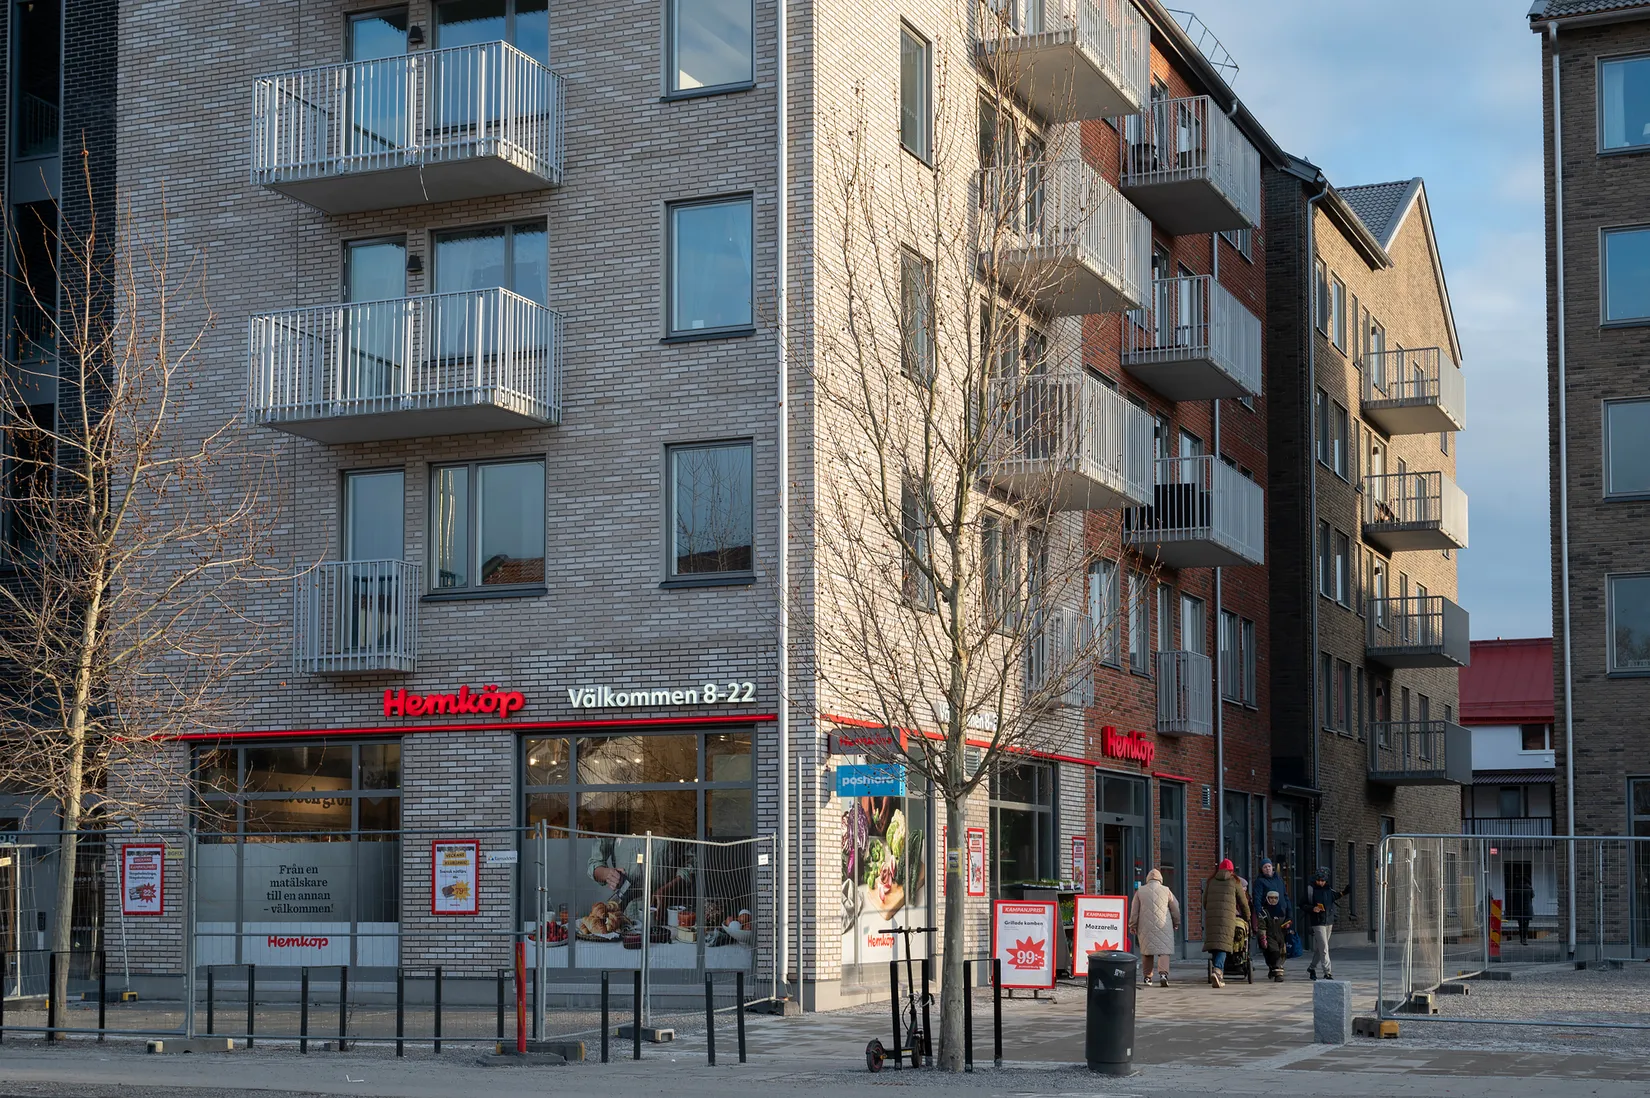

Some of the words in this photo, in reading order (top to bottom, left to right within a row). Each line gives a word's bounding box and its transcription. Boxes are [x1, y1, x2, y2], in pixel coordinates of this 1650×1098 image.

[383, 684, 526, 718] Hemköp
[568, 686, 698, 709] Välkommen
[703, 682, 756, 704] 8-22
[1102, 726, 1155, 767] Hemköp
[279, 863, 304, 874] Från
[306, 866, 319, 874] en
[270, 877, 328, 887] matälskare
[267, 891, 282, 900] till
[284, 892, 296, 900] en
[298, 892, 331, 900] annan
[271, 904, 334, 913] välkommen!
[1085, 923, 1118, 931] Mozzarella
[868, 933, 895, 948] Hemköp
